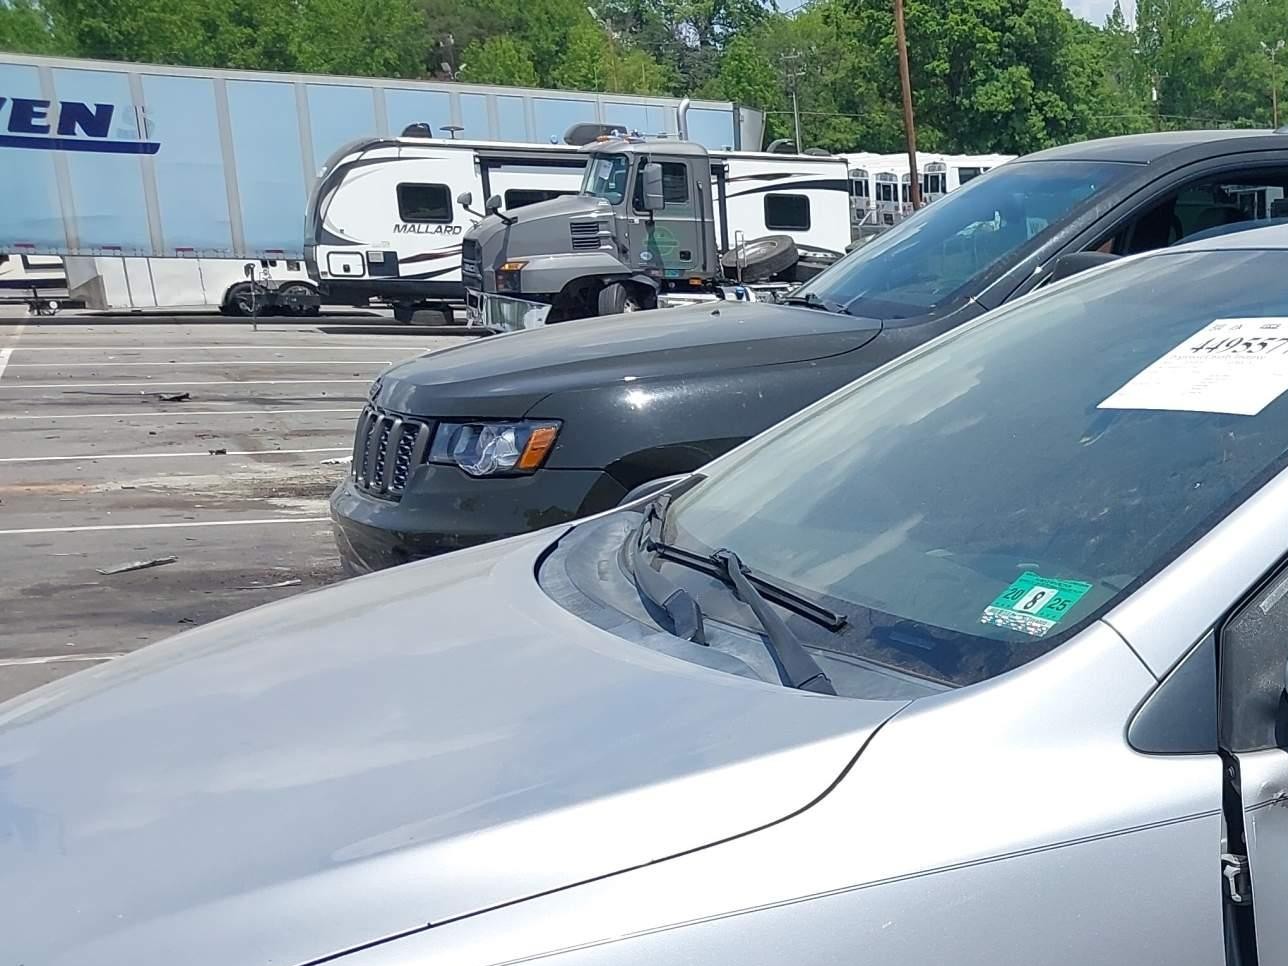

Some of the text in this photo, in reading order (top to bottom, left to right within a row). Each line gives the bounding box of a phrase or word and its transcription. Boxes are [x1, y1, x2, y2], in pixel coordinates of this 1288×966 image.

[393, 223, 462, 235] MALLARD
[1003, 588, 1072, 611] 20 8 25
